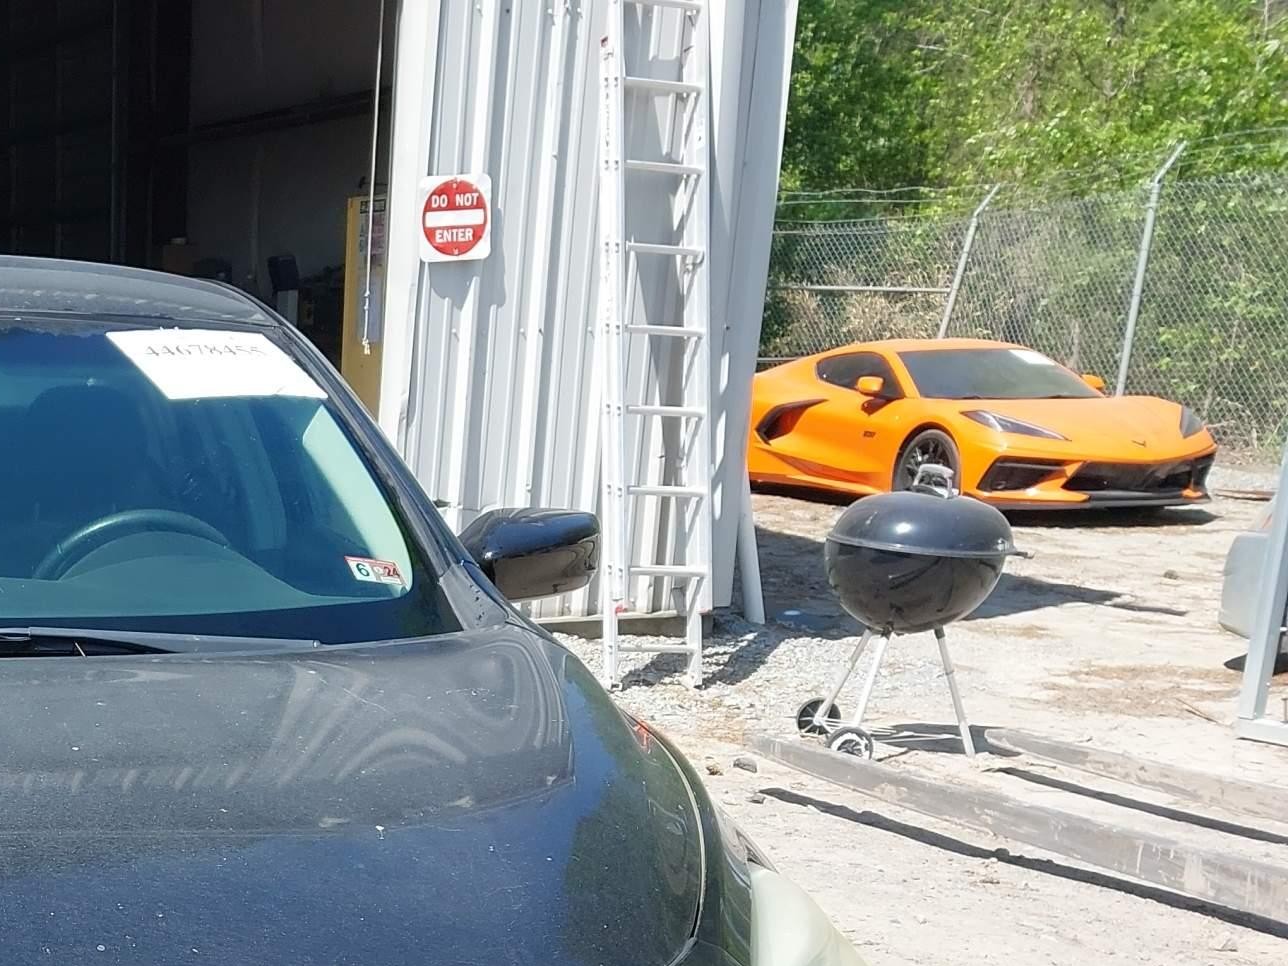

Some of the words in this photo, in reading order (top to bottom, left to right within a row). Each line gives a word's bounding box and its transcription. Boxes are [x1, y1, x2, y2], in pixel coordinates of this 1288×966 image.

[431, 194, 448, 208] DO
[455, 192, 479, 207] NOT
[435, 228, 474, 243] ENTER
[355, 562, 370, 577] 6
